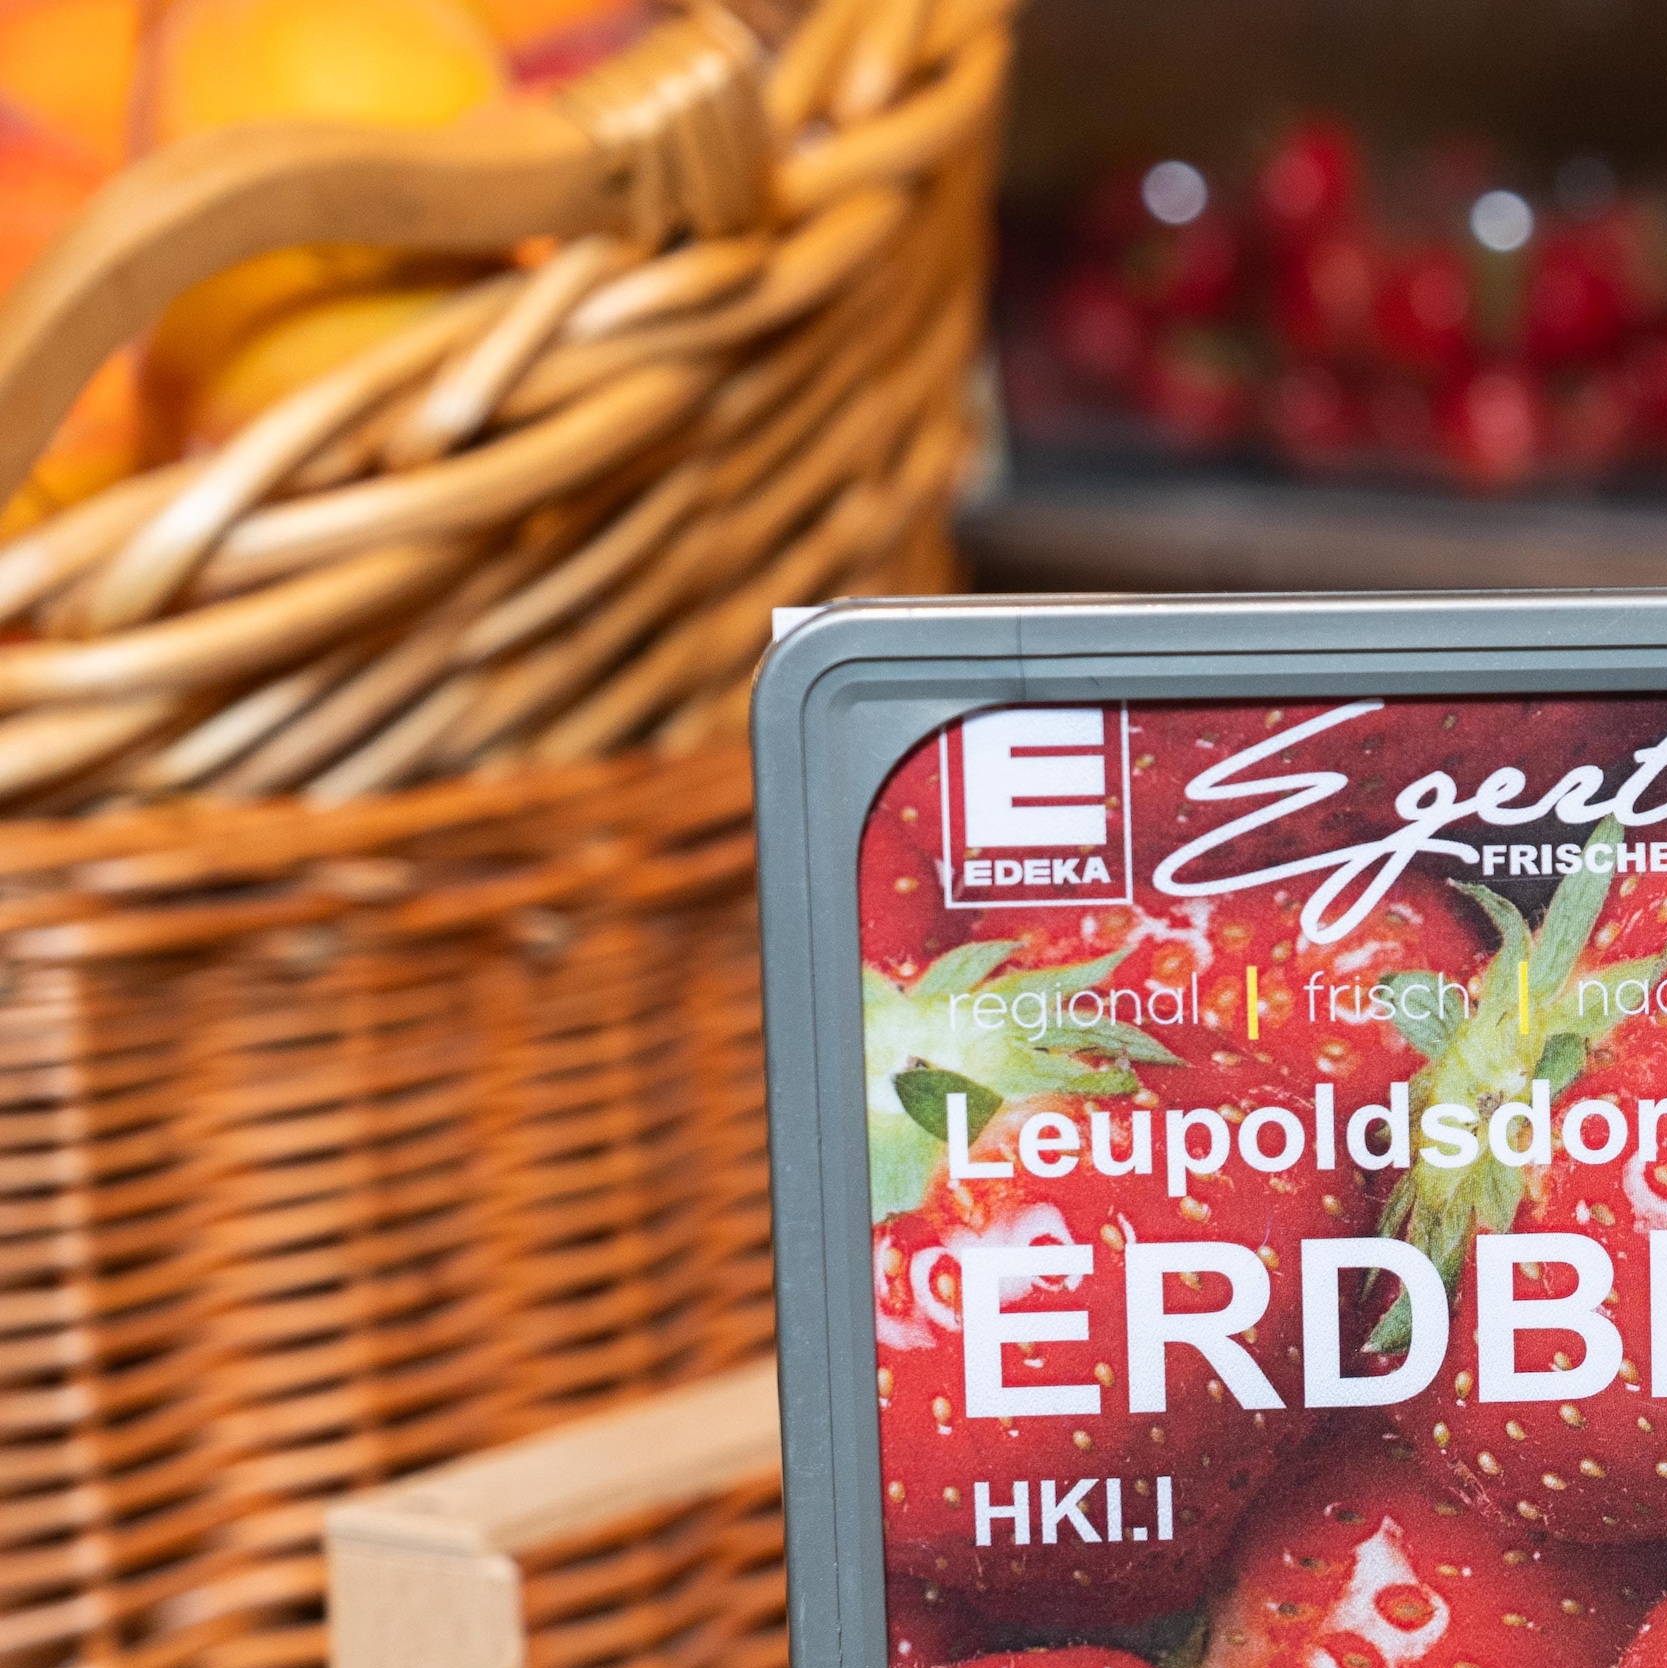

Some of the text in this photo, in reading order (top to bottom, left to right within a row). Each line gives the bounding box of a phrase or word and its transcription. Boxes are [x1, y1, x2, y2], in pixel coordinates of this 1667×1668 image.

[963, 856, 1112, 887] EDEKA
[948, 971, 1200, 1042] regional
[1303, 970, 1470, 1023] frisch
